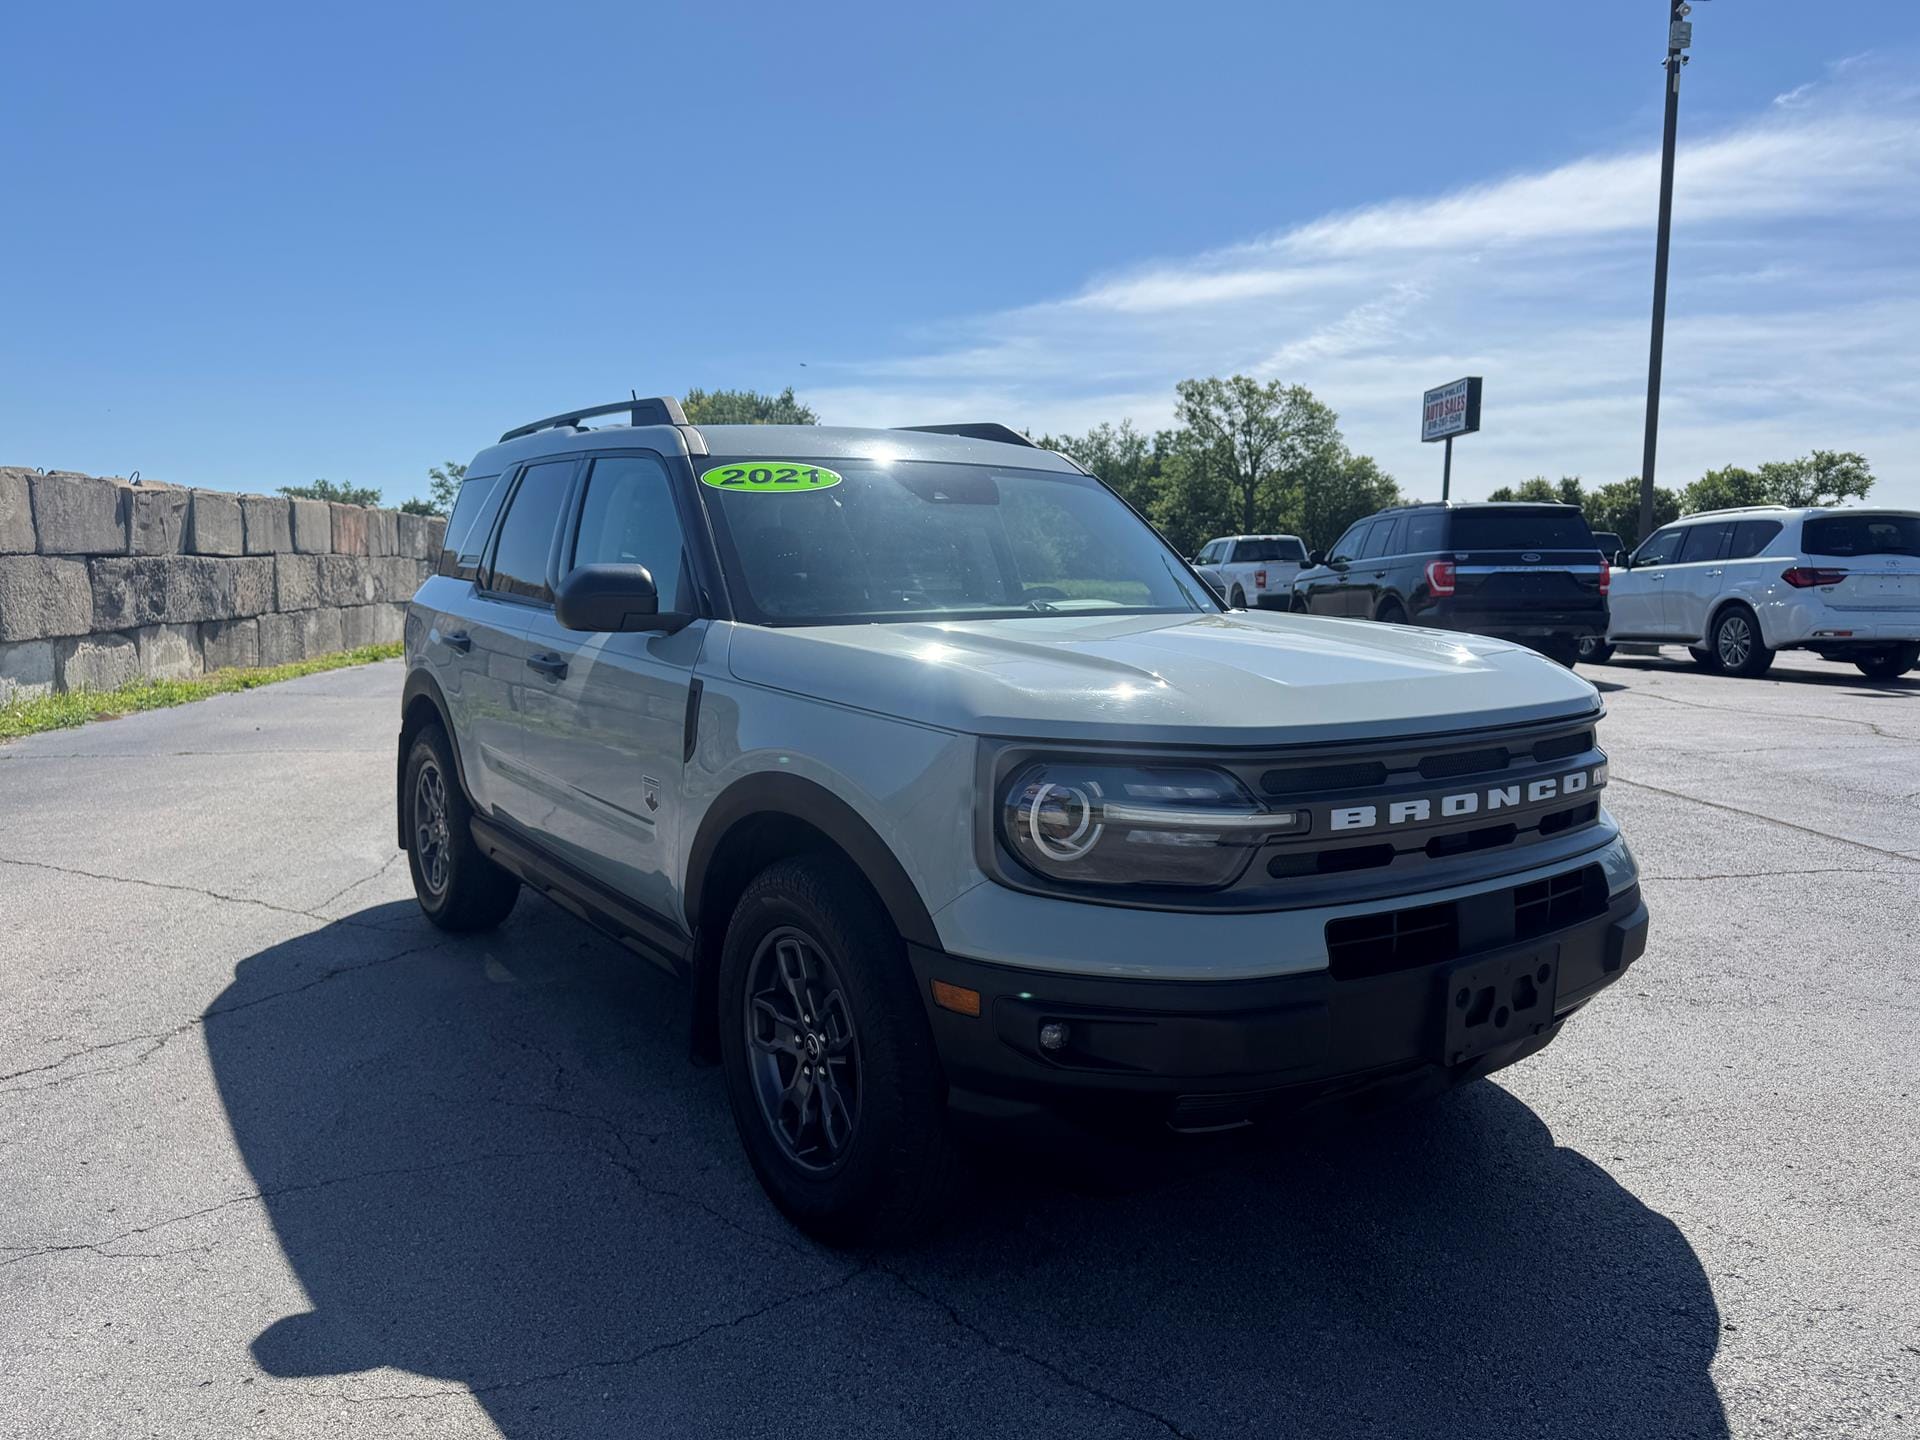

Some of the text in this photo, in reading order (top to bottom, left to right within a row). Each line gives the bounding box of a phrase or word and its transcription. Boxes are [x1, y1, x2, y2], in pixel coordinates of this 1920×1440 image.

[1425, 394, 1466, 421] AUTO SALES
[720, 468, 820, 486] 2021
[1330, 771, 1588, 831] BRONCO
